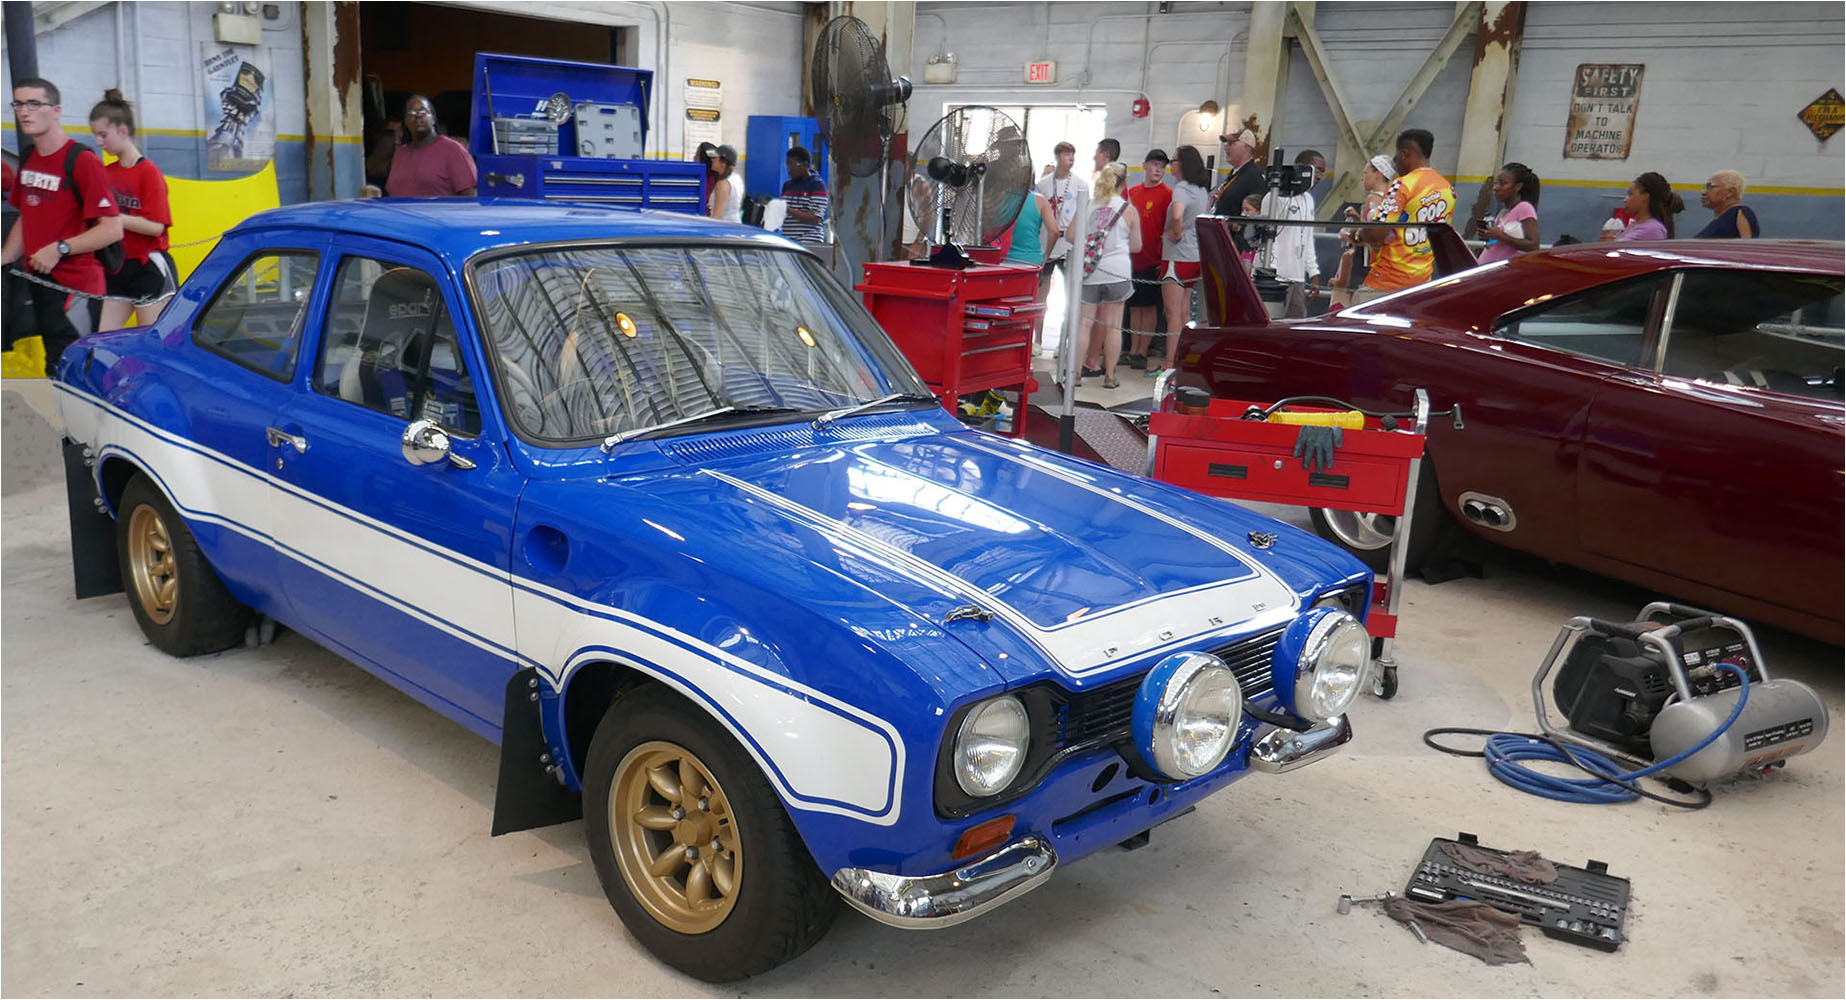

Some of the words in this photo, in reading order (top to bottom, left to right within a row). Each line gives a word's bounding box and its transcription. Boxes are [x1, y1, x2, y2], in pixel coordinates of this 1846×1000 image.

[1029, 63, 1050, 80] EXIT
[1581, 68, 1639, 87] SAFETY
[1585, 87, 1630, 97] FIRST
[1574, 103, 1603, 113] DON'T
[1607, 103, 1634, 114] TALK
[1595, 117, 1608, 127] TO
[1575, 129, 1622, 140] MACHINE
[1571, 143, 1625, 154] OPERATOR
[1417, 199, 1447, 222] POP
